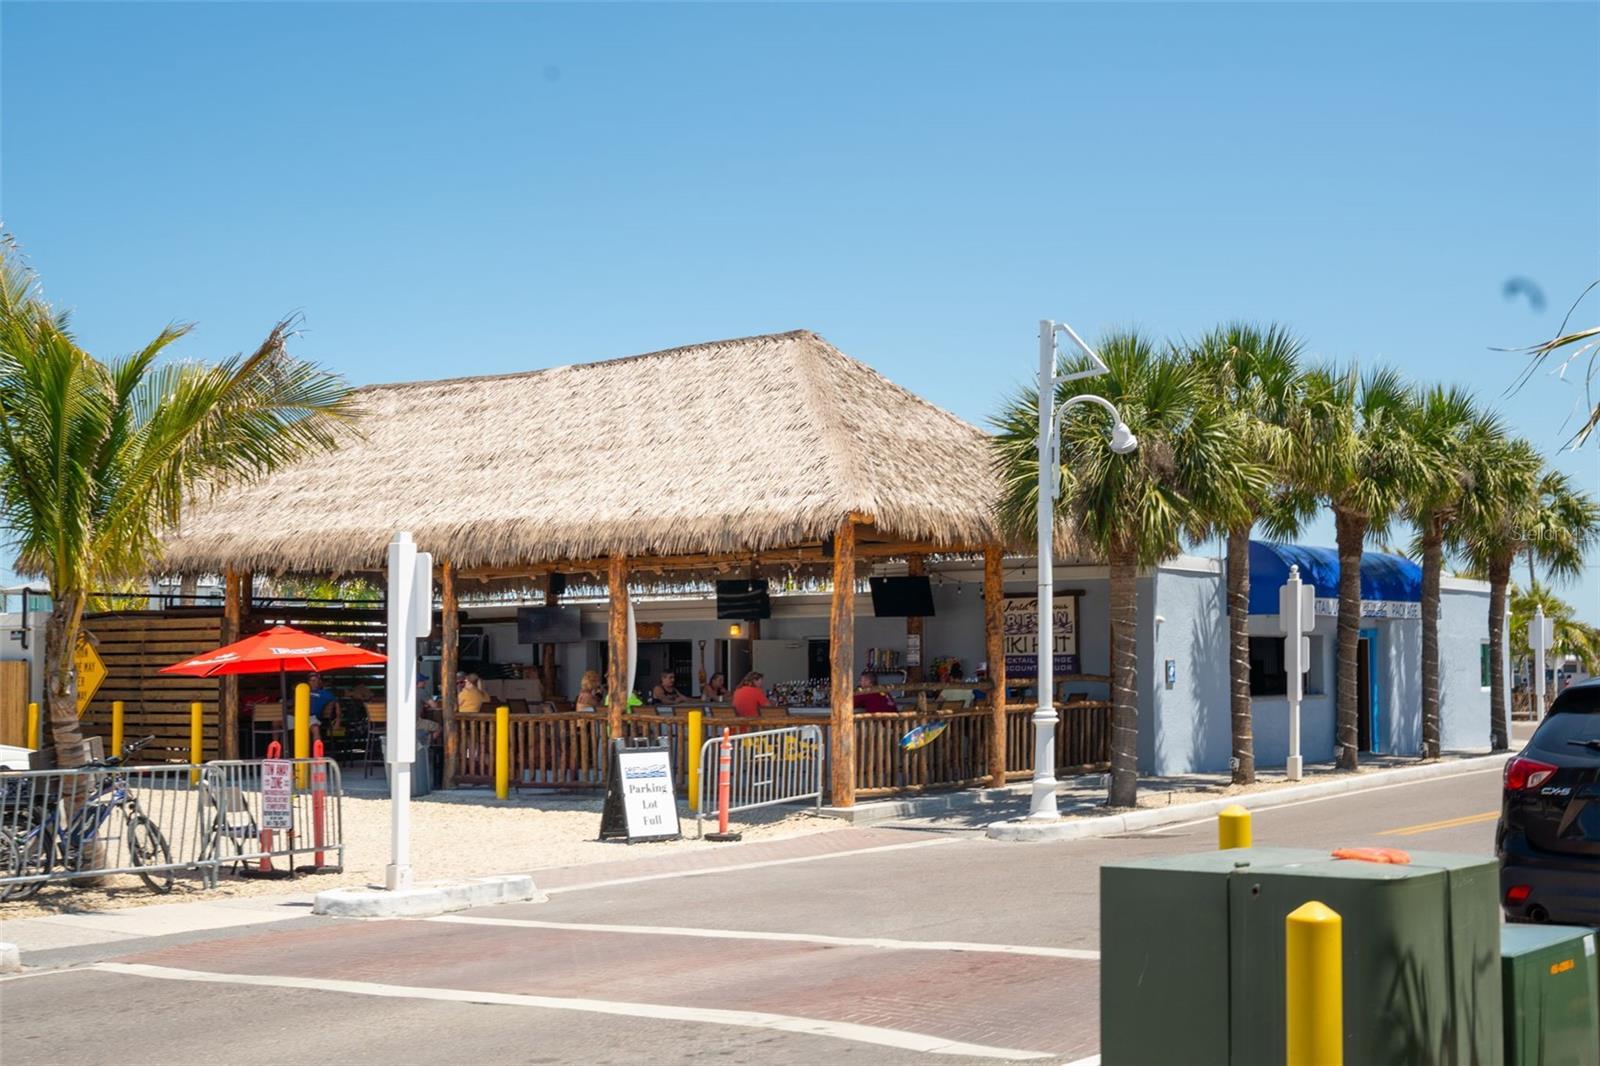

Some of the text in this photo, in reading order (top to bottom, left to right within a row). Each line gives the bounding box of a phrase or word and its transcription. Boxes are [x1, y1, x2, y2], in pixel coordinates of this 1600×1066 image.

[1006, 636, 1028, 653] IKI
[1007, 664, 1037, 672] COUNT
[629, 783, 668, 795] Parking
[642, 800, 658, 810] Lot
[643, 815, 662, 826] Full
